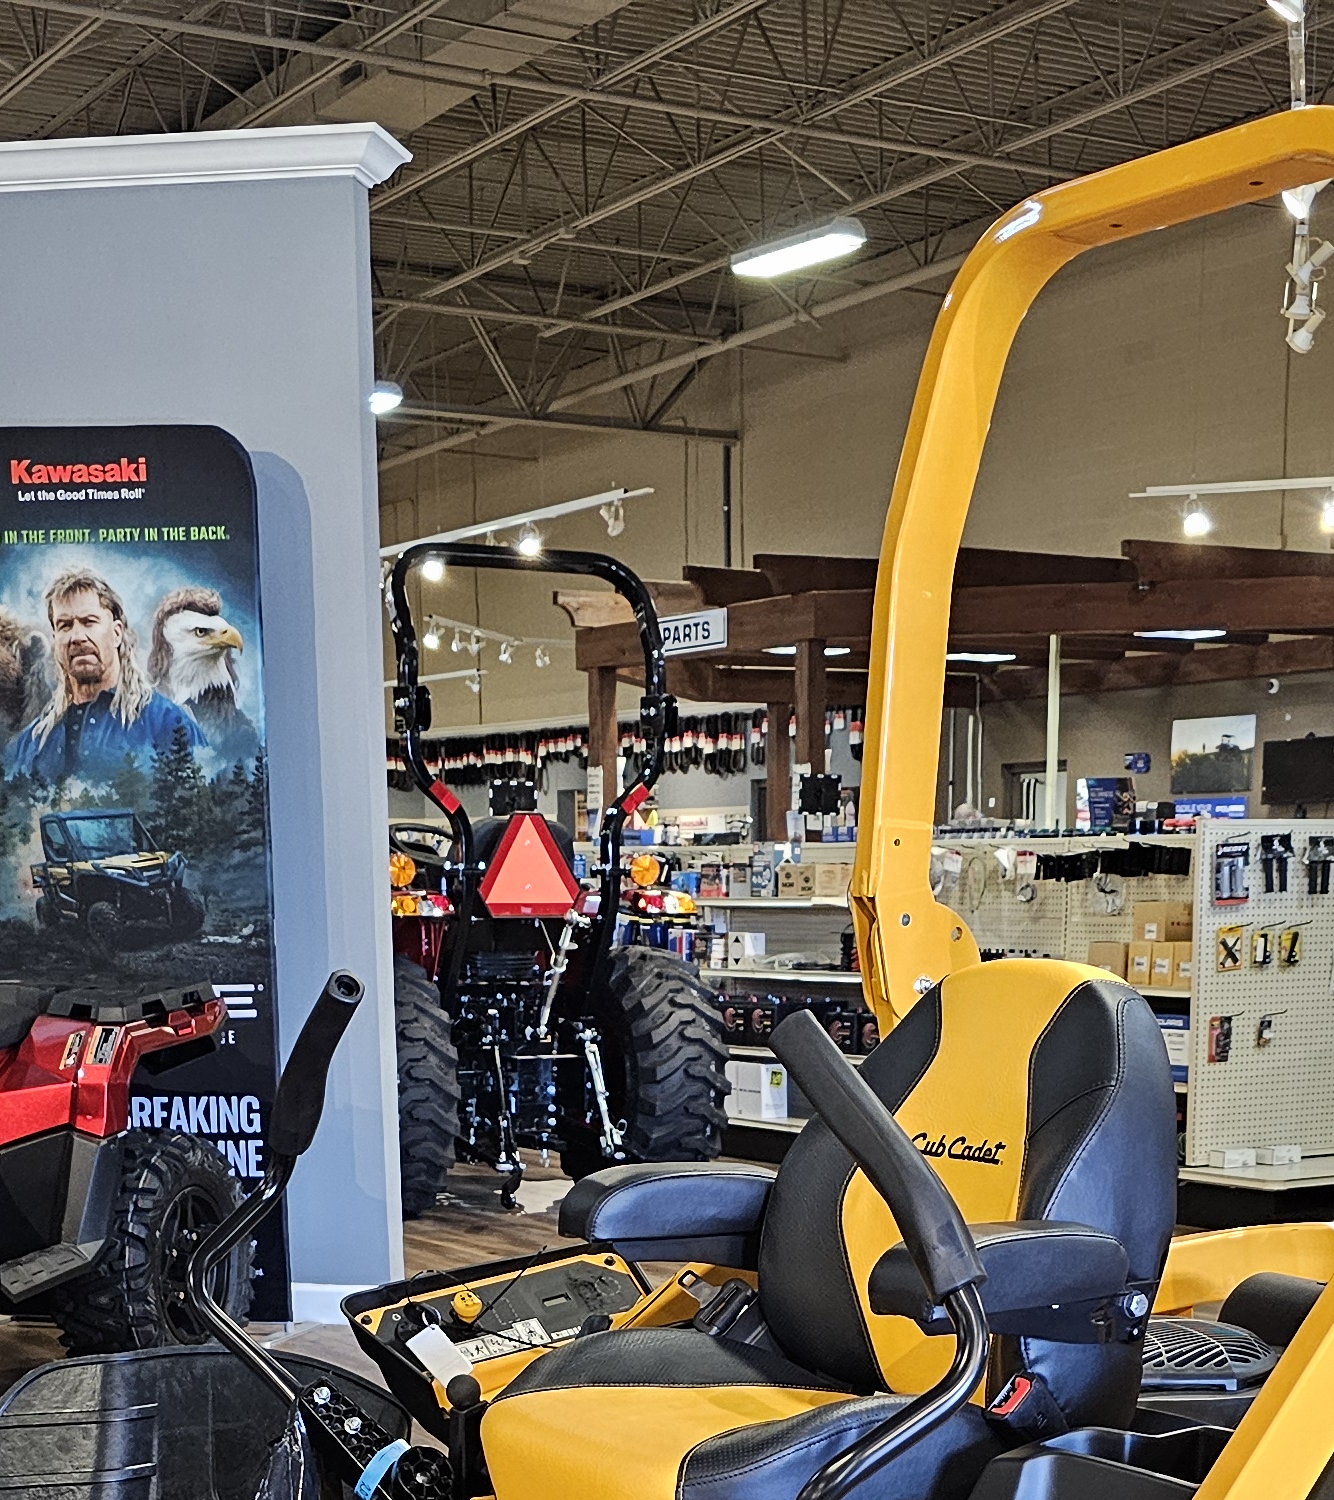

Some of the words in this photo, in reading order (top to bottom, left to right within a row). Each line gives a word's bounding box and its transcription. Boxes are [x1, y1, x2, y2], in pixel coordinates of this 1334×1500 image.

[10, 457, 147, 484] Kawasaki
[18, 490, 36, 502] Let
[38, 489, 55, 501] the
[57, 489, 85, 501] Good
[87, 488, 119, 500] Times
[4, 530, 18, 545] IN
[21, 529, 46, 545] THE
[50, 528, 95, 544] FRONT.
[99, 527, 140, 543] PARTY
[144, 527, 158, 542] IN
[162, 526, 187, 541] THE
[190, 525, 231, 541] BACK.
[663, 621, 711, 645] PARTS
[127, 1095, 262, 1134] REAKING
[911, 1132, 947, 1158] Cub
[948, 1135, 1007, 1166] Cadet
